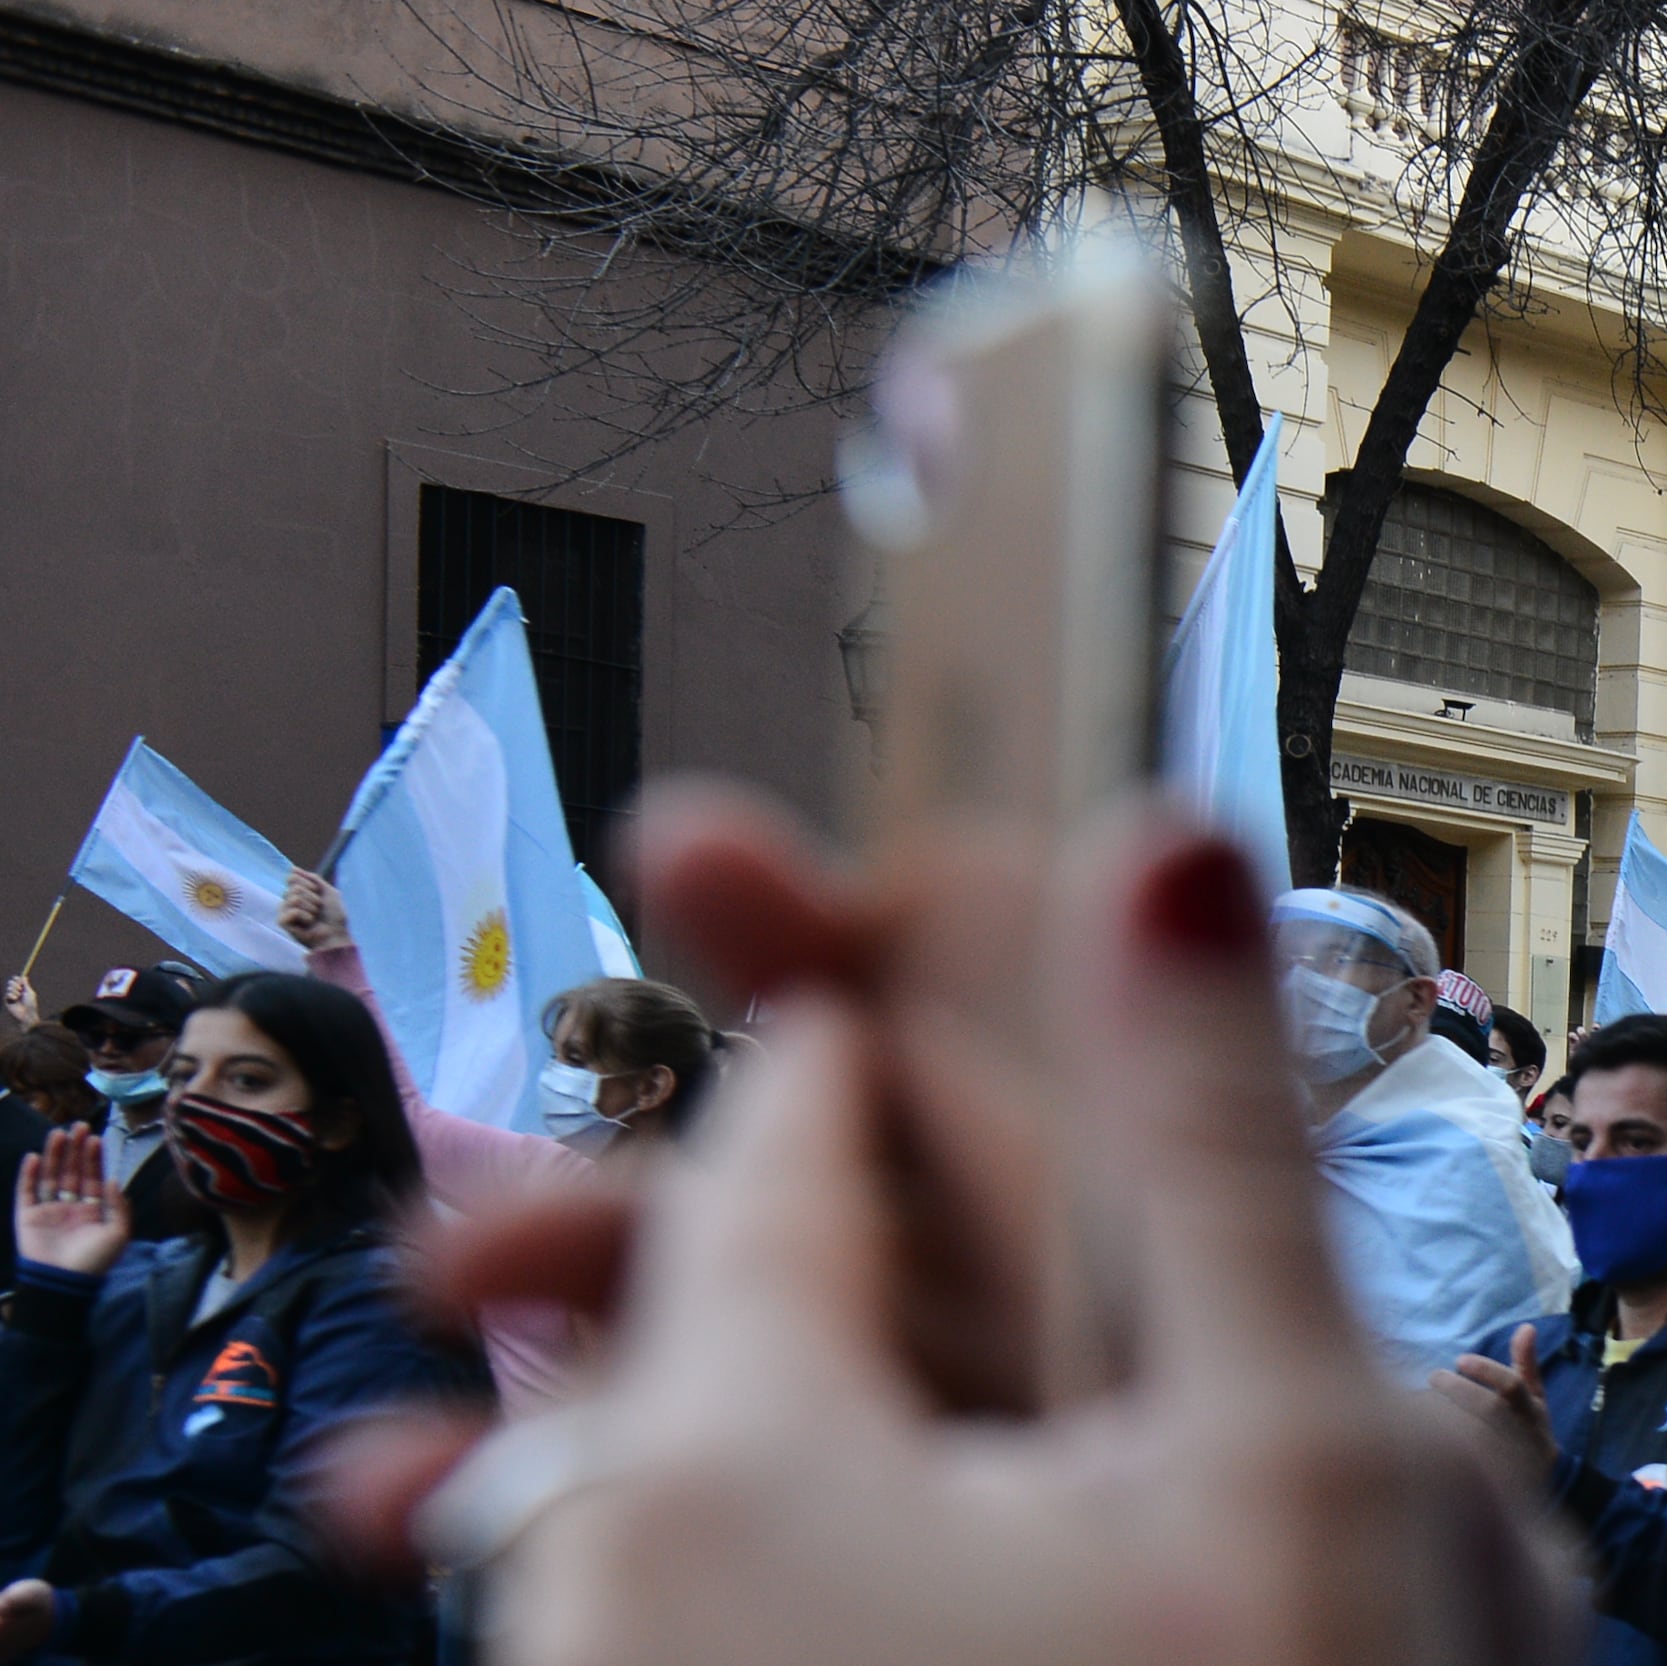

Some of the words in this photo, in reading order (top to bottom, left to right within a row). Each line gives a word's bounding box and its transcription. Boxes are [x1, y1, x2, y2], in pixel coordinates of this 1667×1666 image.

[1399, 772, 1468, 801] NACIONAL
[1473, 784, 1493, 805] DE
[1497, 788, 1557, 815] CIENCIAS
